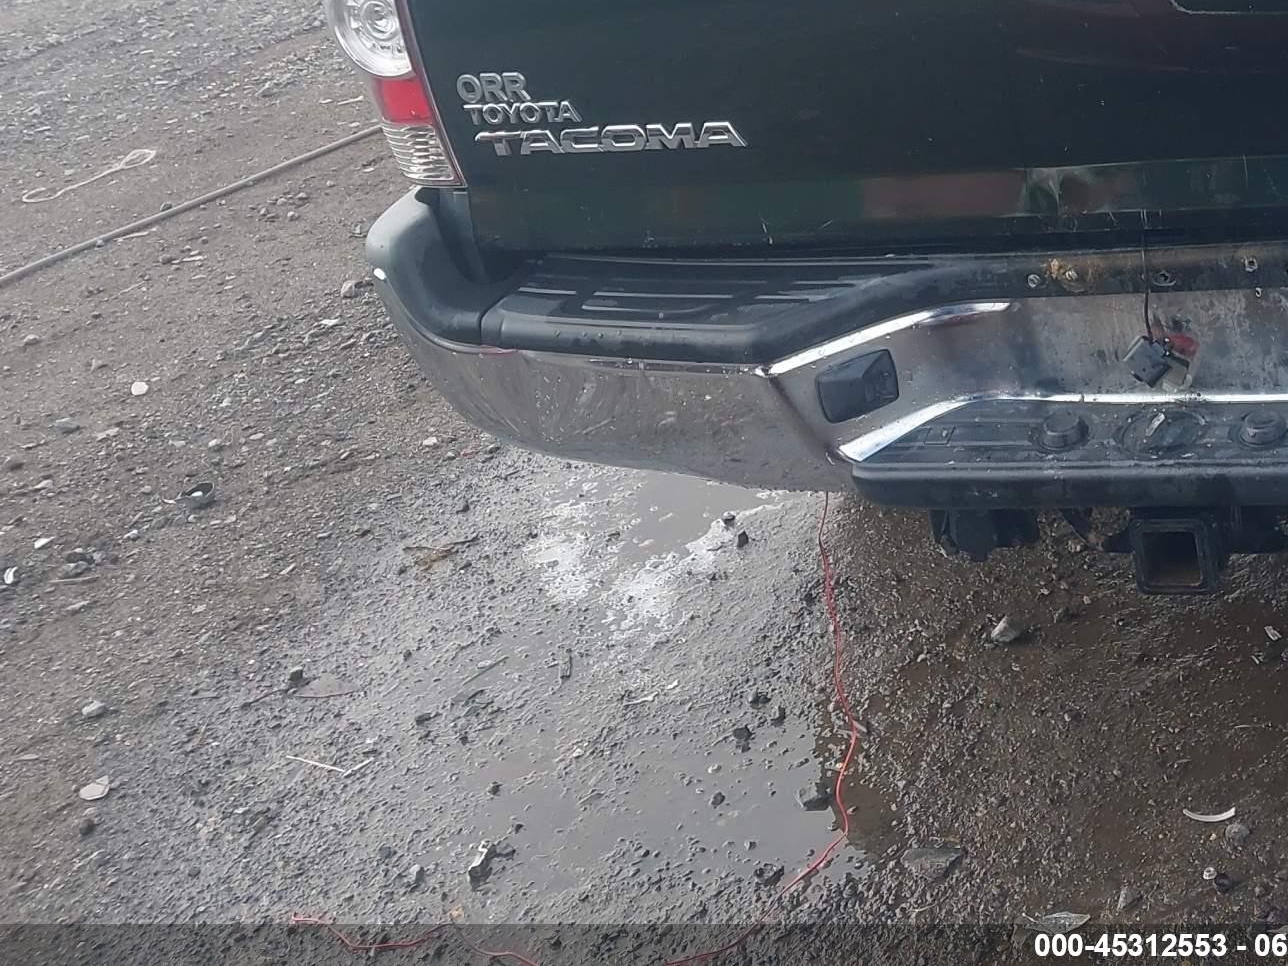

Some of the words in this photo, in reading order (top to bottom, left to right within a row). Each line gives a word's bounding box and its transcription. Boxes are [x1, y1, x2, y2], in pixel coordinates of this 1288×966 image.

[456, 71, 532, 103] ORR
[463, 100, 583, 126] TOYOTA
[474, 121, 748, 156] TACOMA
